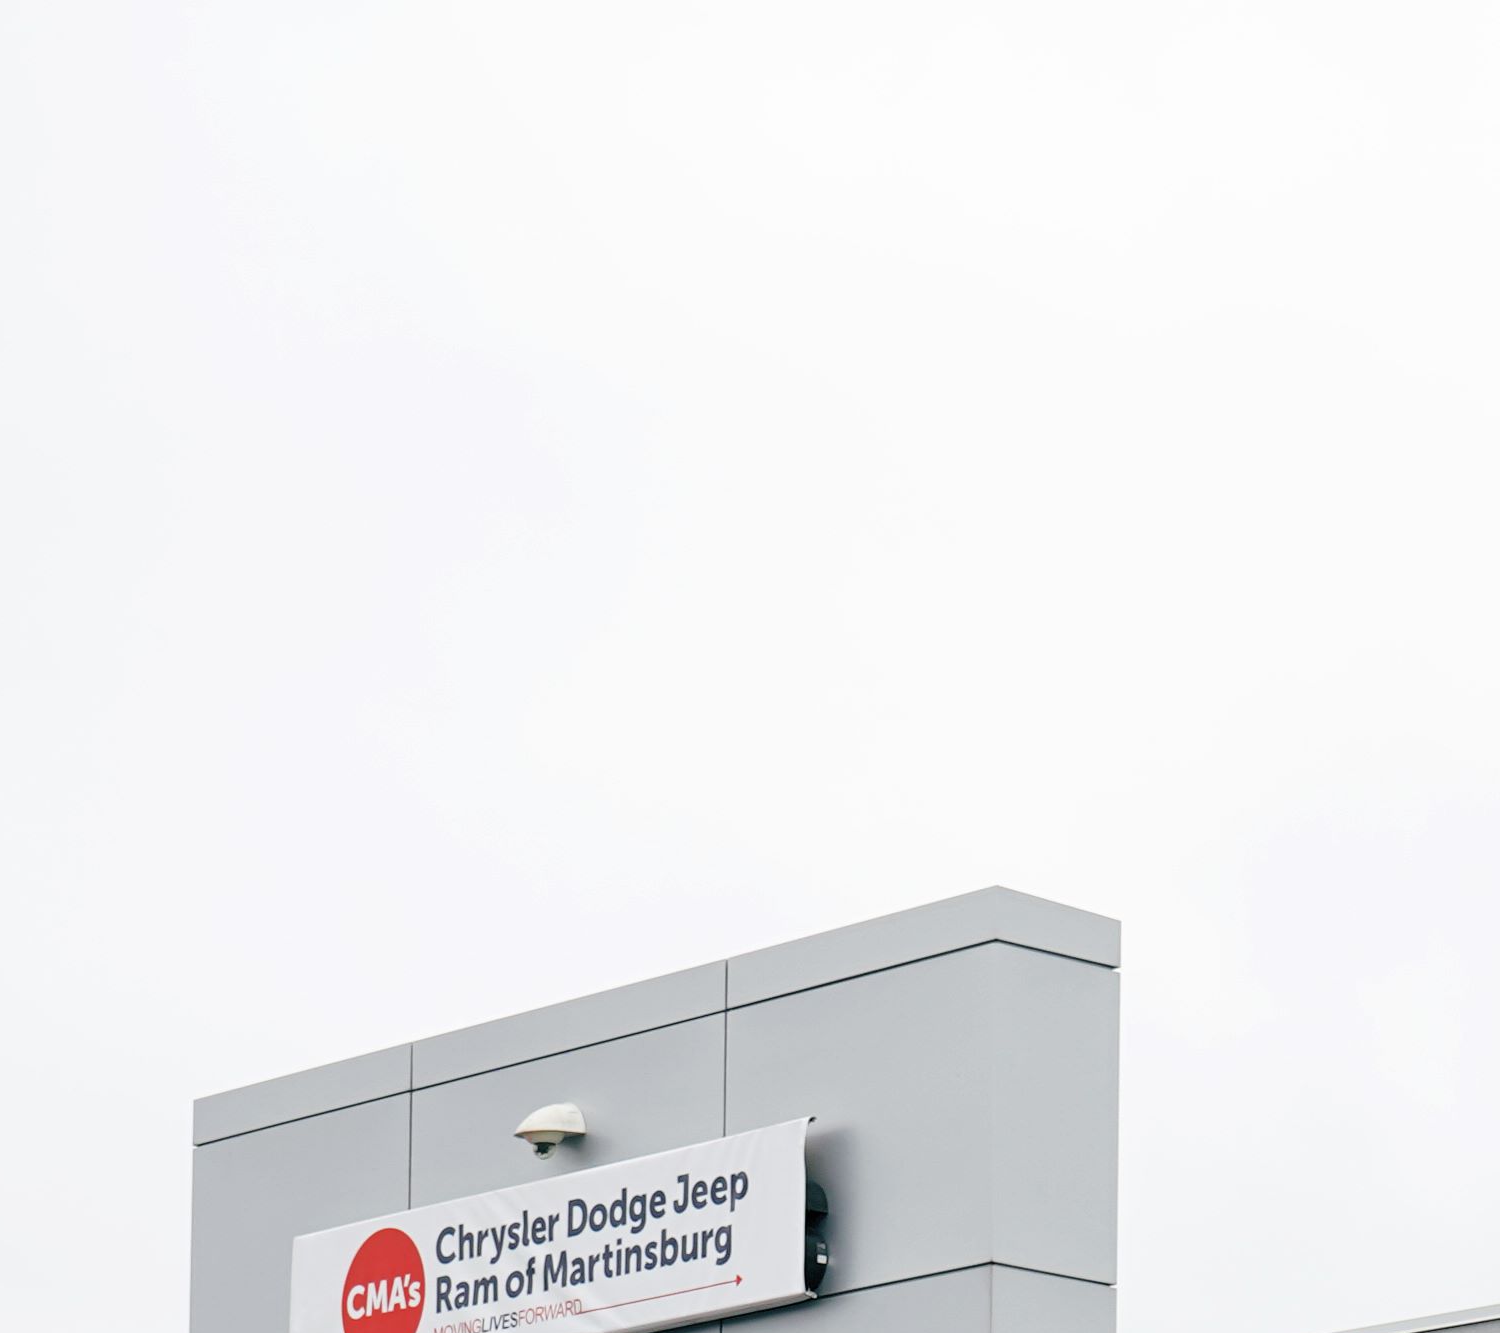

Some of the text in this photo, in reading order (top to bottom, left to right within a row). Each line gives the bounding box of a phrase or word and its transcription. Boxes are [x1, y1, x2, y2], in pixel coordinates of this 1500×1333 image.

[435, 1167, 749, 1266] Chrysler Dodge Jeep
[346, 1273, 422, 1321] CMA's
[435, 1223, 733, 1314] Ram of Martinsburg
